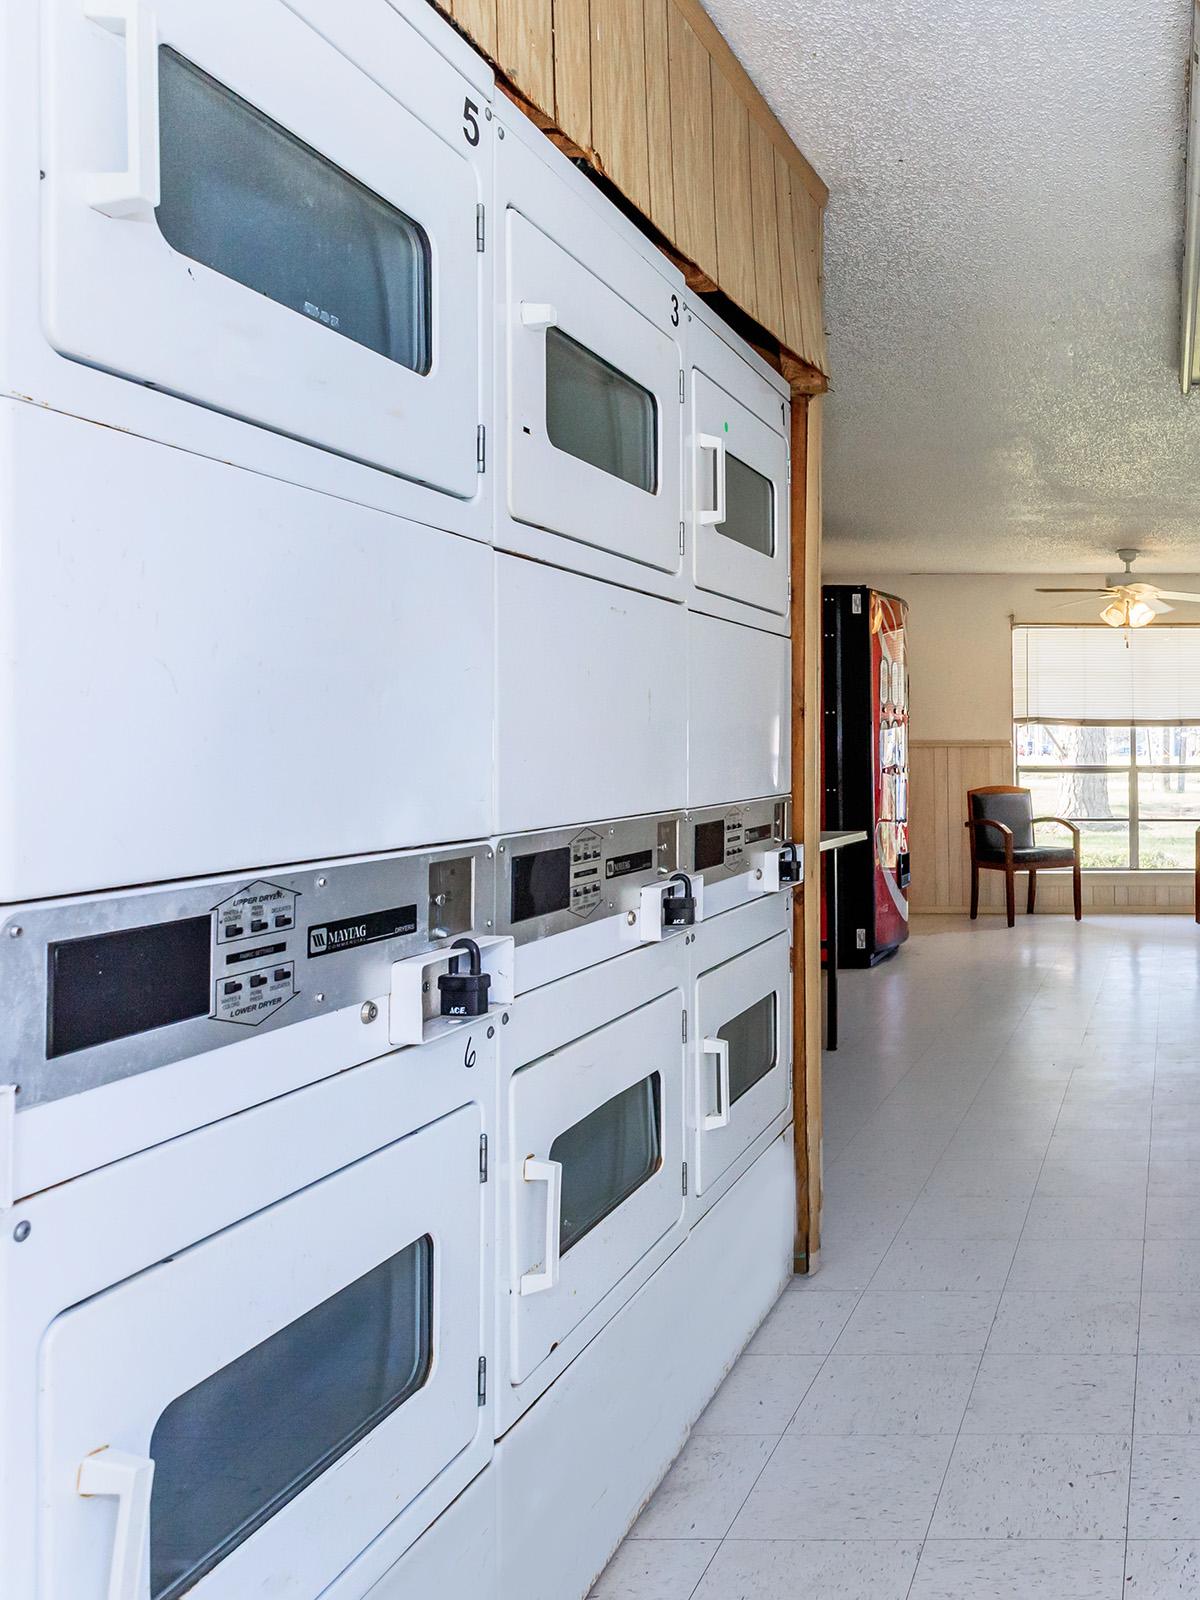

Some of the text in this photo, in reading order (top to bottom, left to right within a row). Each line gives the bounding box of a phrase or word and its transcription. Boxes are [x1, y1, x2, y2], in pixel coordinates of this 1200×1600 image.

[463, 96, 480, 147] 5
[671, 294, 679, 327] 3
[781, 402, 786, 426] 1
[233, 897, 258, 907] UPPER
[328, 924, 367, 945] MAYTAG
[394, 923, 416, 934] DRYERS
[230, 997, 283, 1017] LOWER DRYER
[465, 1036, 477, 1069] 6
